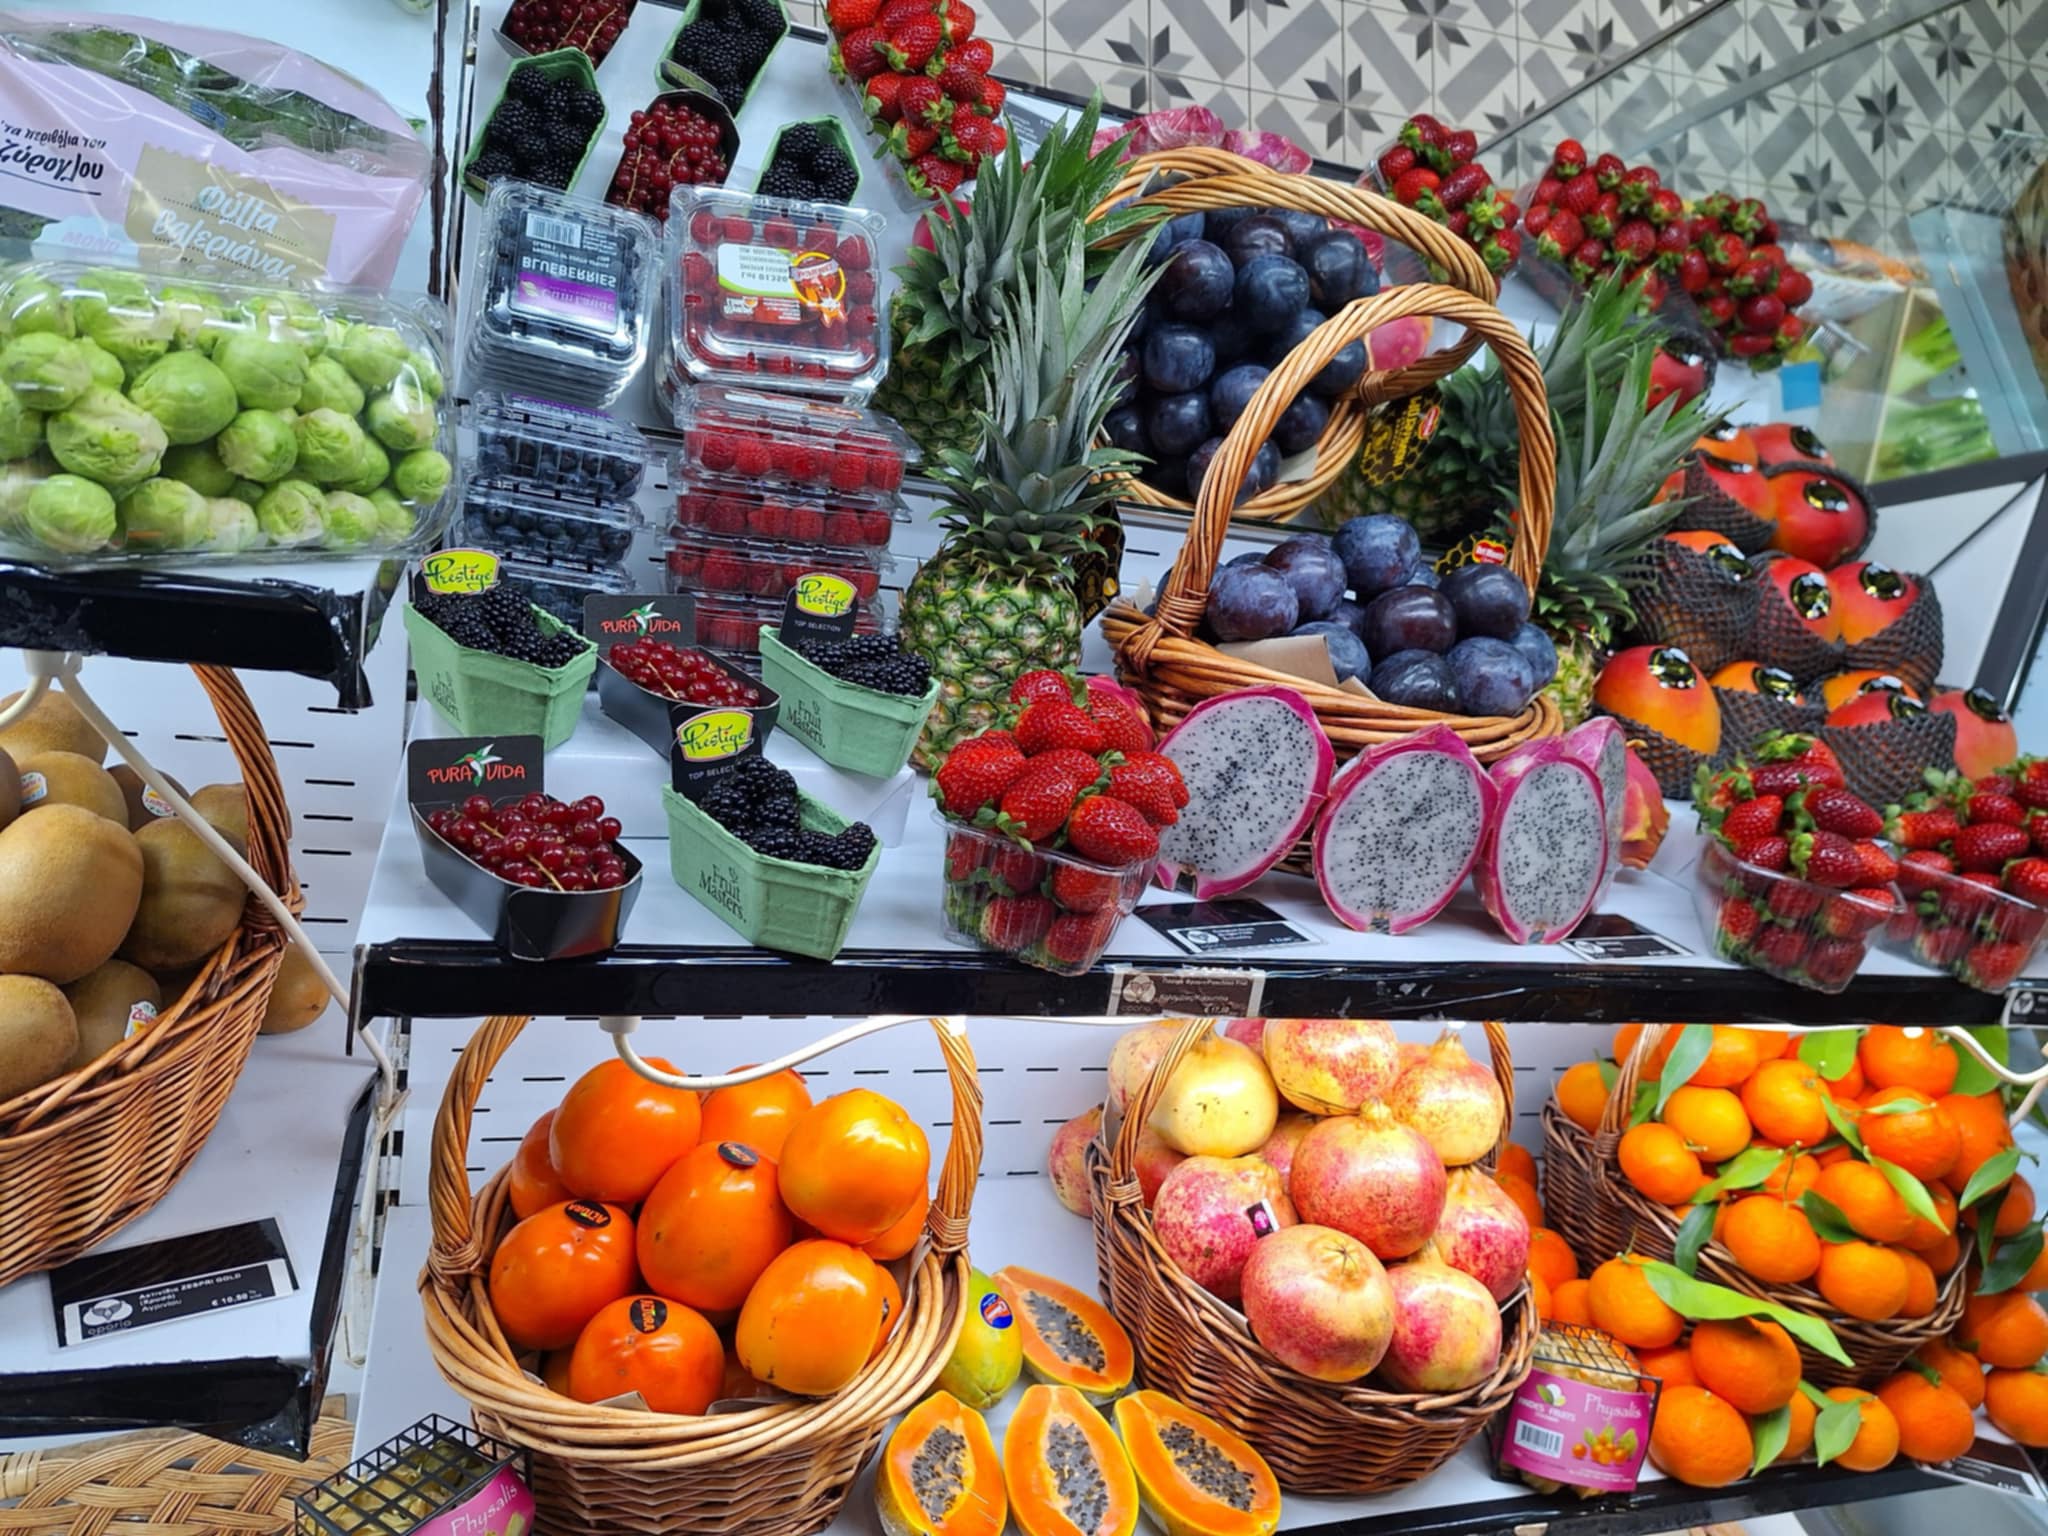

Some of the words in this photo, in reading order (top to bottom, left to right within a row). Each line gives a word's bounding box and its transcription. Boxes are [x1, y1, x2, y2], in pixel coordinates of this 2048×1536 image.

[424, 556, 499, 593] Prestige
[797, 579, 853, 617] Prestige
[601, 618, 638, 634] PURA
[648, 619, 681, 634] VIDA
[808, 622, 841, 632] SELECTION
[681, 722, 754, 755] Prestige
[427, 764, 474, 784] PURA
[486, 763, 526, 782] VIDA
[689, 770, 705, 780] TOP
[706, 764, 735, 777] SELECT
[712, 863, 741, 903] Fruit
[181, 1279, 214, 1292] ZESPRI
[215, 1272, 242, 1284] GOLD
[1584, 1392, 1642, 1420] Physalis
[450, 1483, 519, 1536] Physalis
